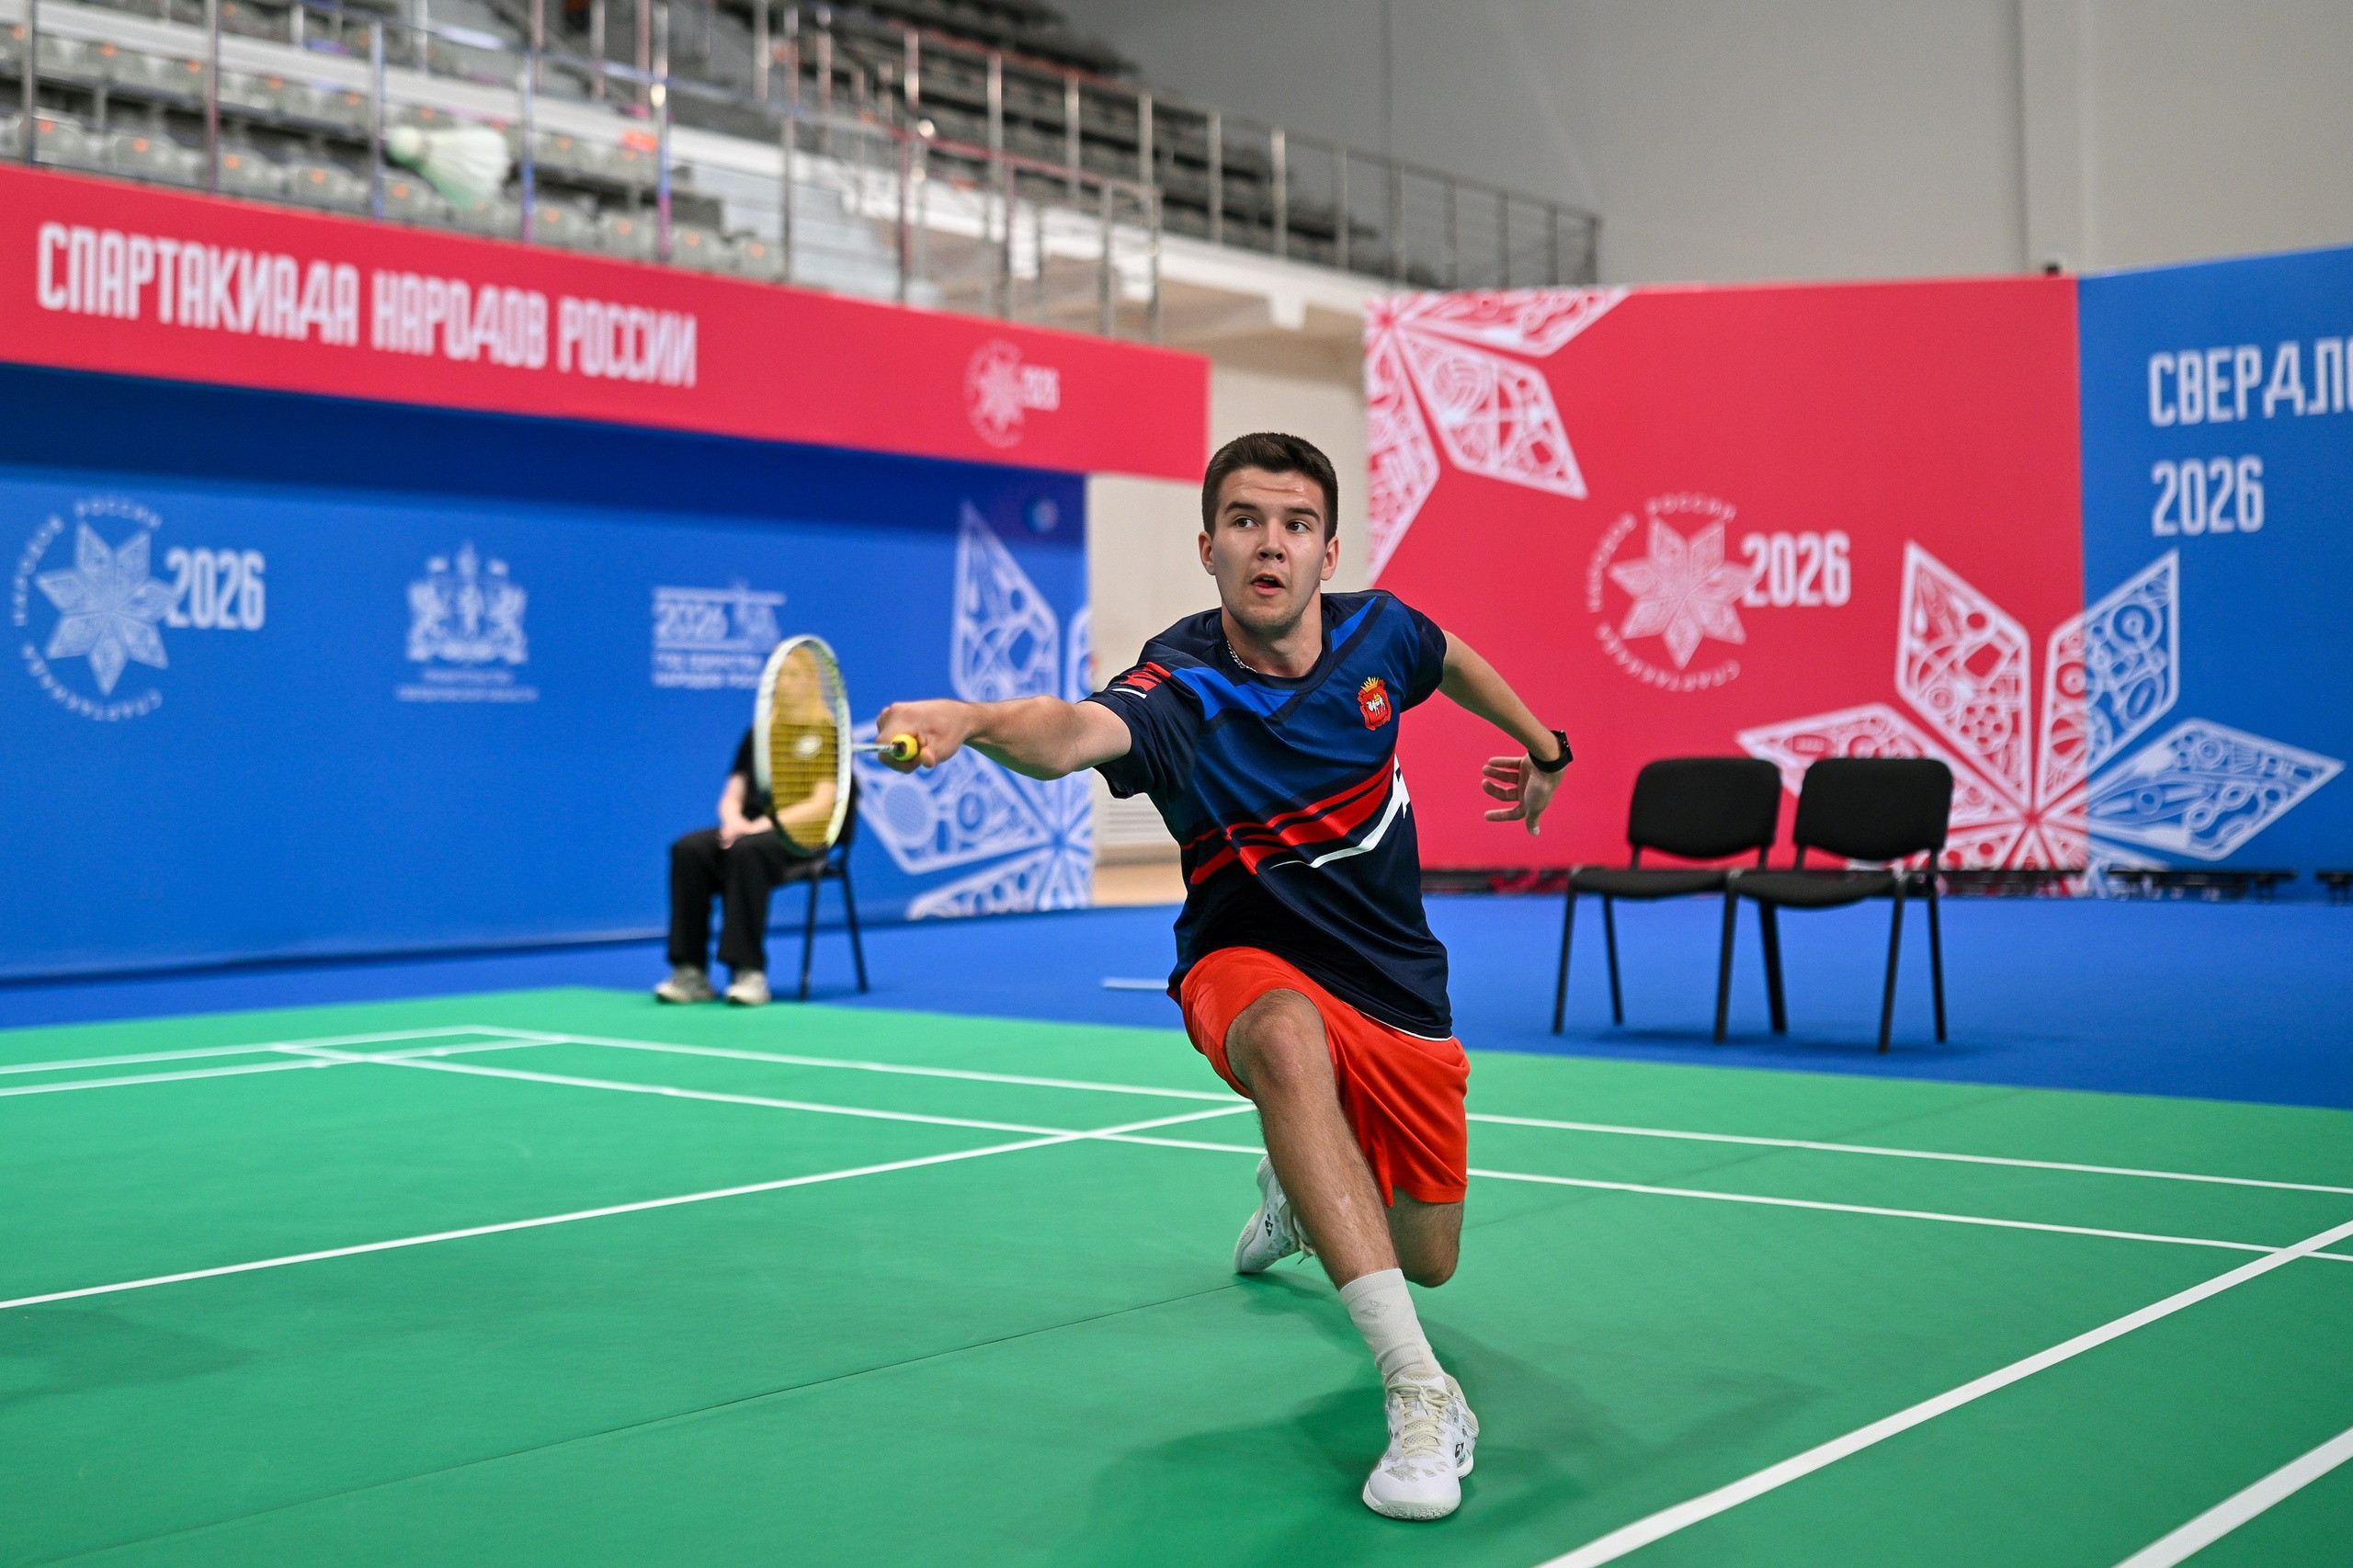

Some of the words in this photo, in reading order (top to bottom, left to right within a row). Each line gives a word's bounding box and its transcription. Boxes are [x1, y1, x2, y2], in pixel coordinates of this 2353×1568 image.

[37, 221, 359, 347] СПАРТАКИАДА
[370, 268, 547, 369] НАРОДОВ
[557, 296, 698, 388] РОССИИ
[2148, 335, 2353, 427] СВЕРДЛ
[2151, 454, 2265, 537] 2026
[165, 546, 266, 631] 2026
[1741, 529, 1850, 607] 2026
